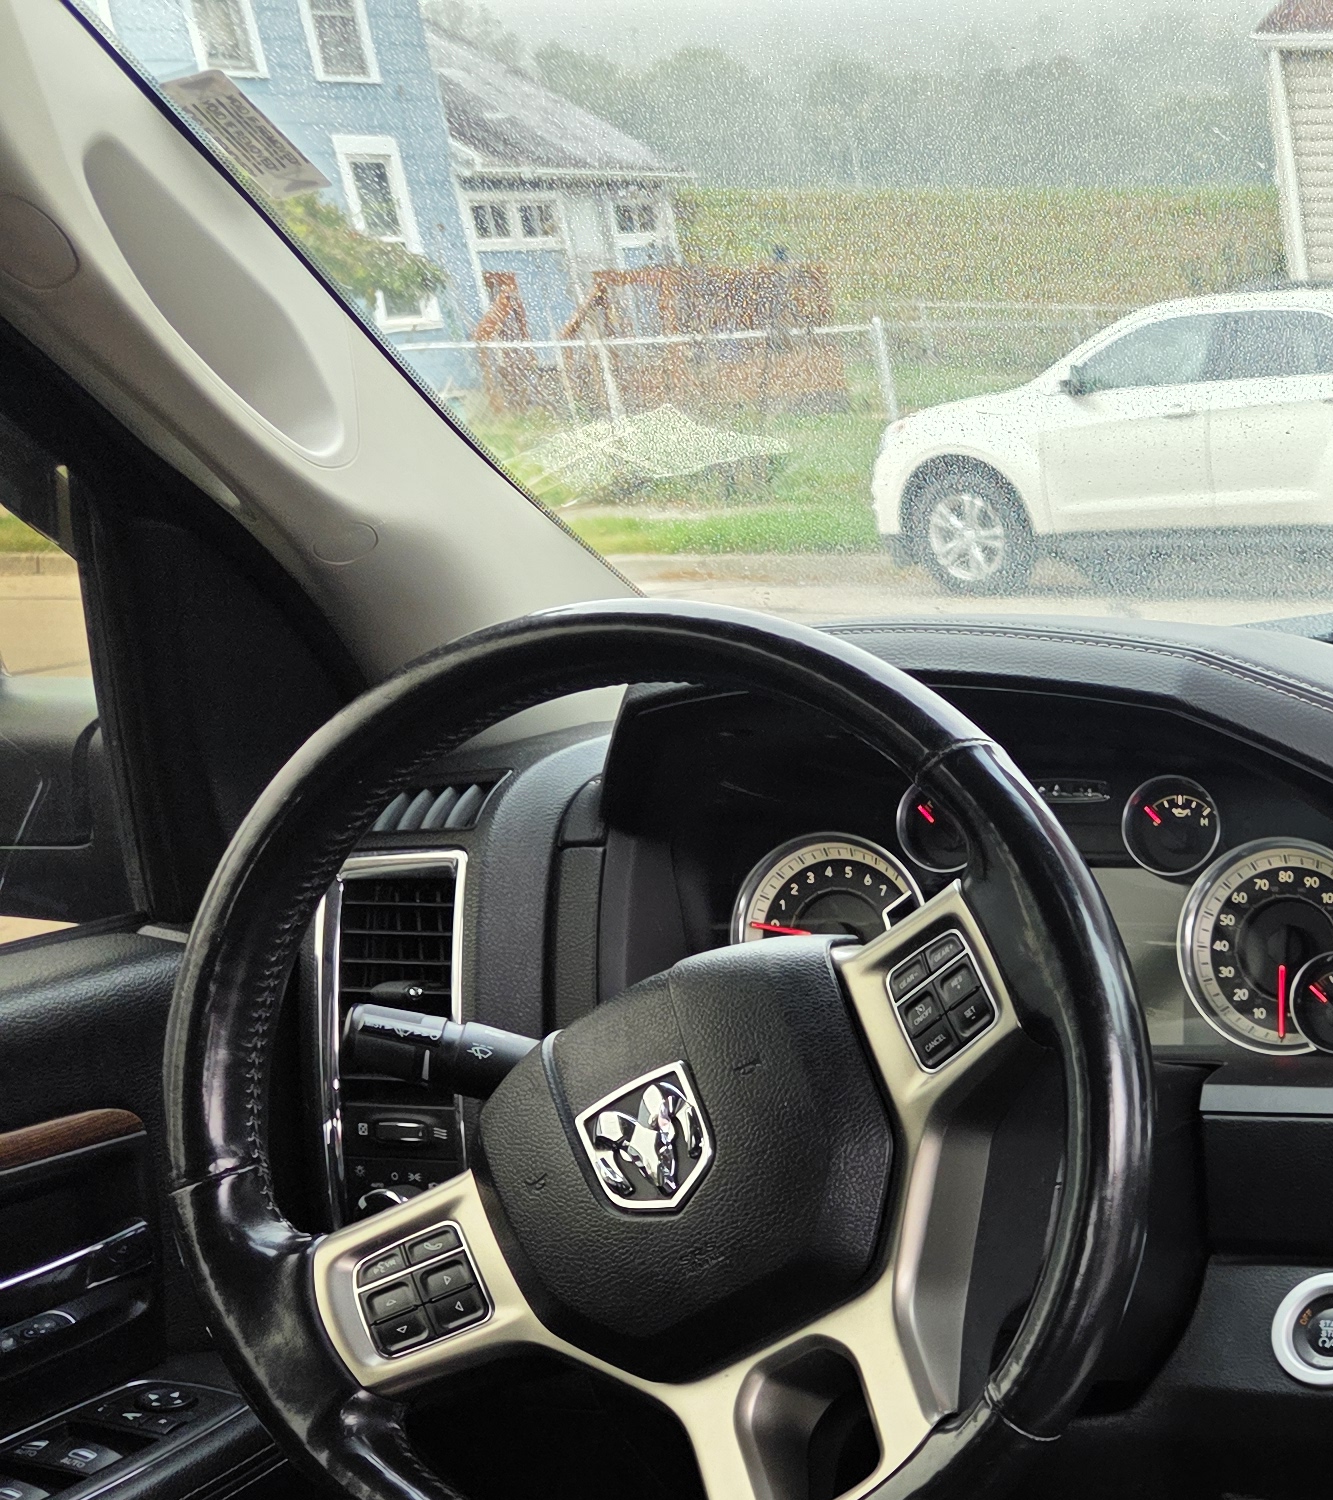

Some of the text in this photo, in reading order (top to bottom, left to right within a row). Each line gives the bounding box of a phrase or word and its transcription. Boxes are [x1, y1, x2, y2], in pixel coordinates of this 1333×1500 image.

[202, 99, 228, 121] VOID
[806, 871, 815, 884] 3
[825, 865, 833, 877] 4
[844, 865, 853, 878] 5
[1278, 871, 1294, 883] 80
[864, 873, 873, 886] 6
[1253, 878, 1269, 891] 70
[1303, 876, 1319, 888] 90
[790, 883, 799, 896] 2
[879, 884, 888, 897] 7
[1231, 891, 1248, 904] 60
[779, 899, 786, 910] 1
[1219, 914, 1236, 926] 50
[1212, 940, 1229, 952] 40
[1218, 966, 1235, 979] 30
[1233, 988, 1249, 1001] 20
[1252, 1007, 1267, 1019] 10
[924, 1033, 947, 1053] CANCEL
[60, 1457, 86, 1469] AUTO
